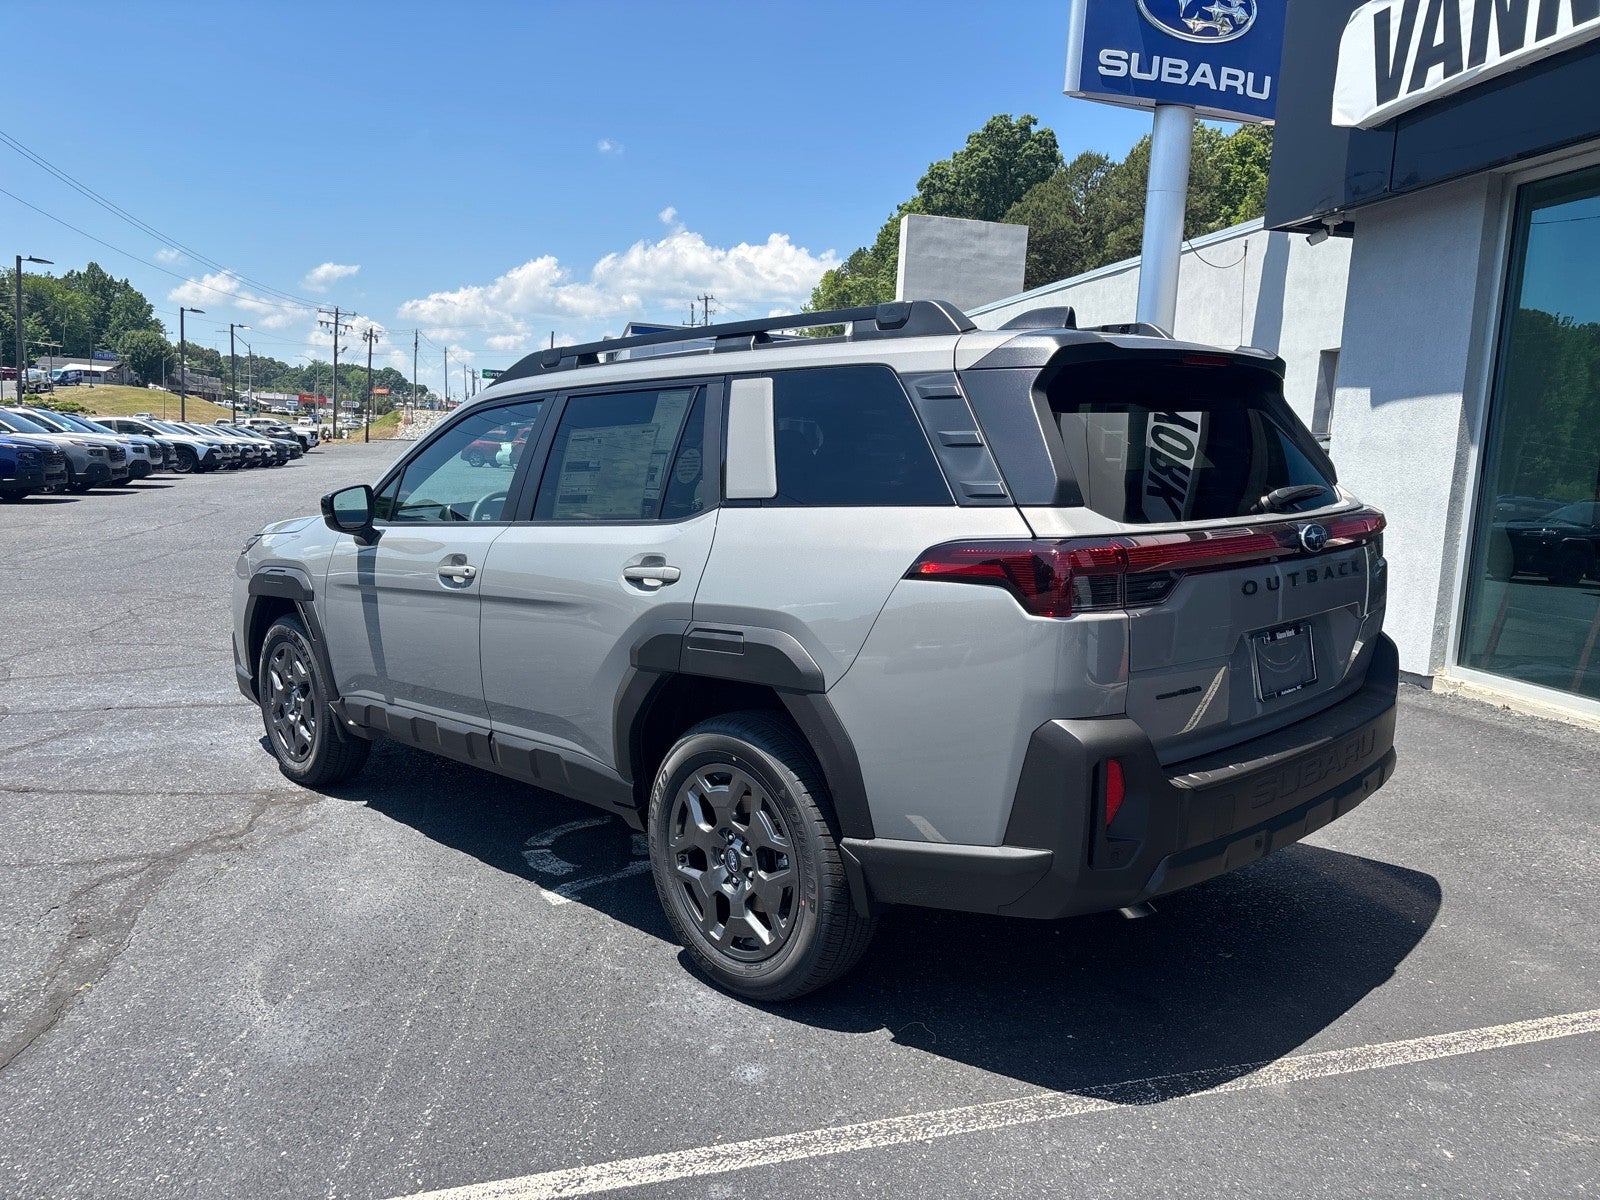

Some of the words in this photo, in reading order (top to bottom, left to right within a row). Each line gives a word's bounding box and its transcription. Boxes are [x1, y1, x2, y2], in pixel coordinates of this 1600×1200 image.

[1098, 48, 1272, 100] SUBARU
[1242, 561, 1360, 595] OUTBACK
[1249, 728, 1376, 809] SUBARU
